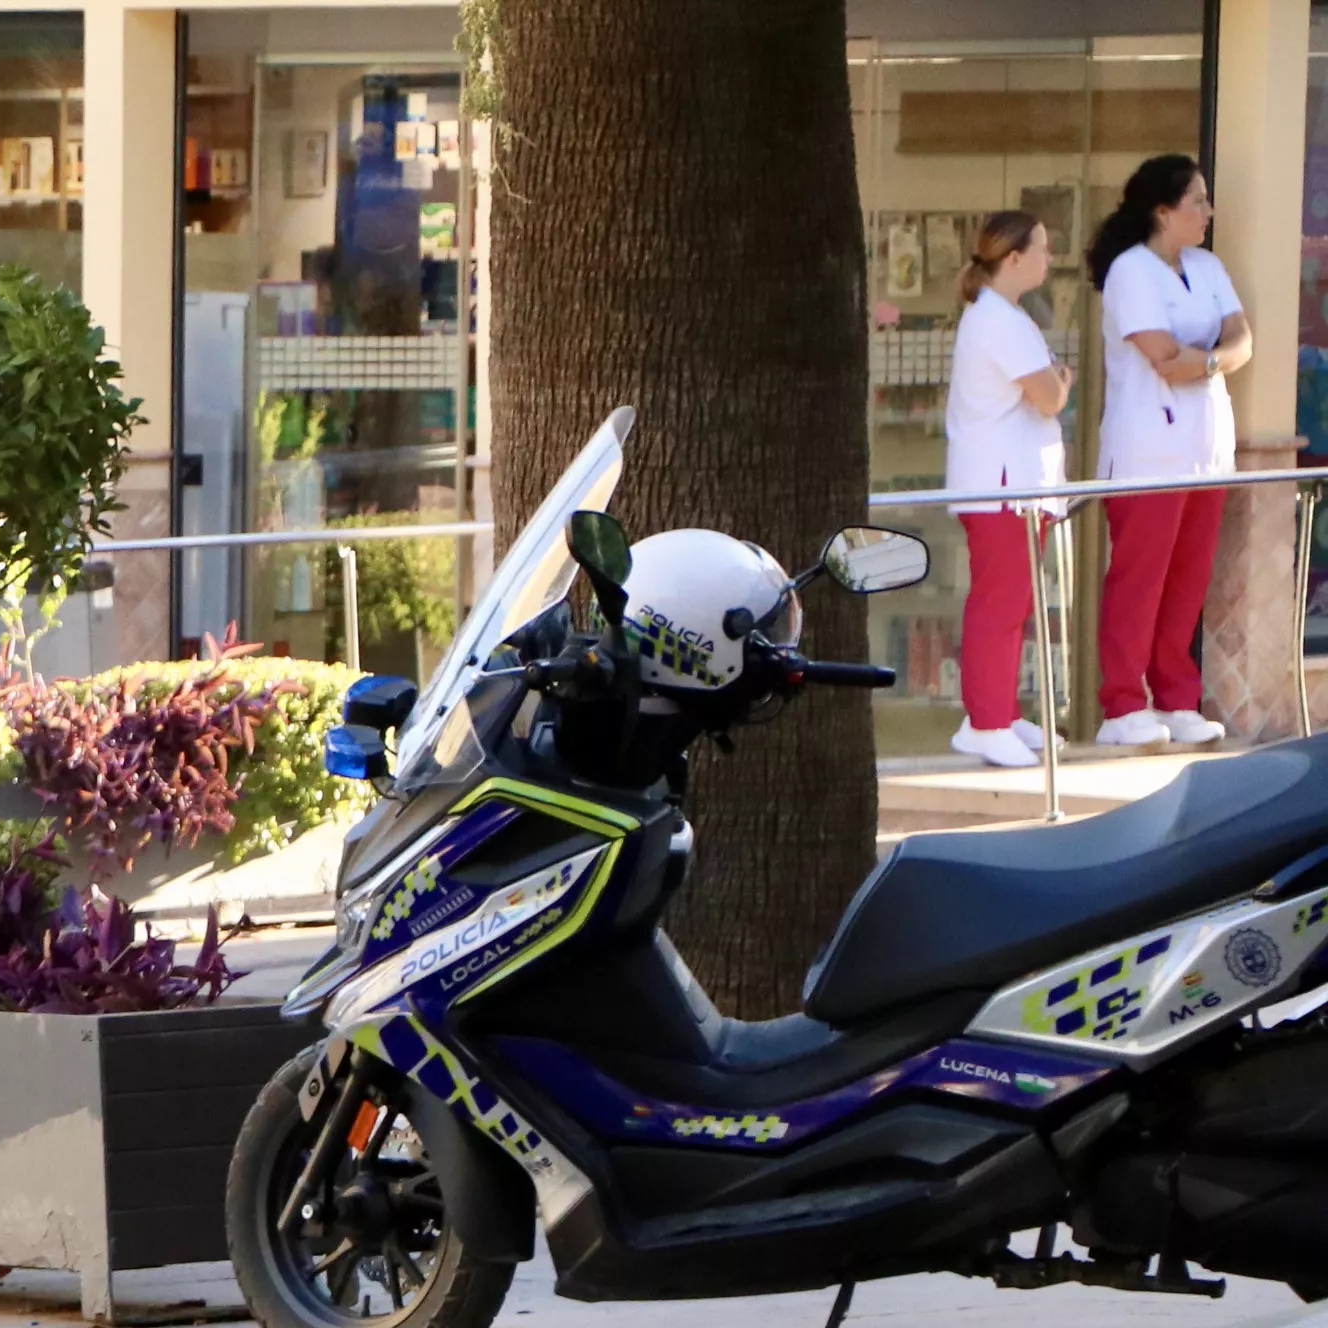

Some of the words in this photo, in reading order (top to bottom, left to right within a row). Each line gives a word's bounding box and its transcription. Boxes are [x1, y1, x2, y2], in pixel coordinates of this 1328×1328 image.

[640, 605, 715, 652] POLICÍA
[400, 908, 508, 985] POLICÍA
[441, 944, 511, 991] LOCAL
[1169, 991, 1222, 1025] M-6
[940, 1057, 1012, 1084] LUCENA
